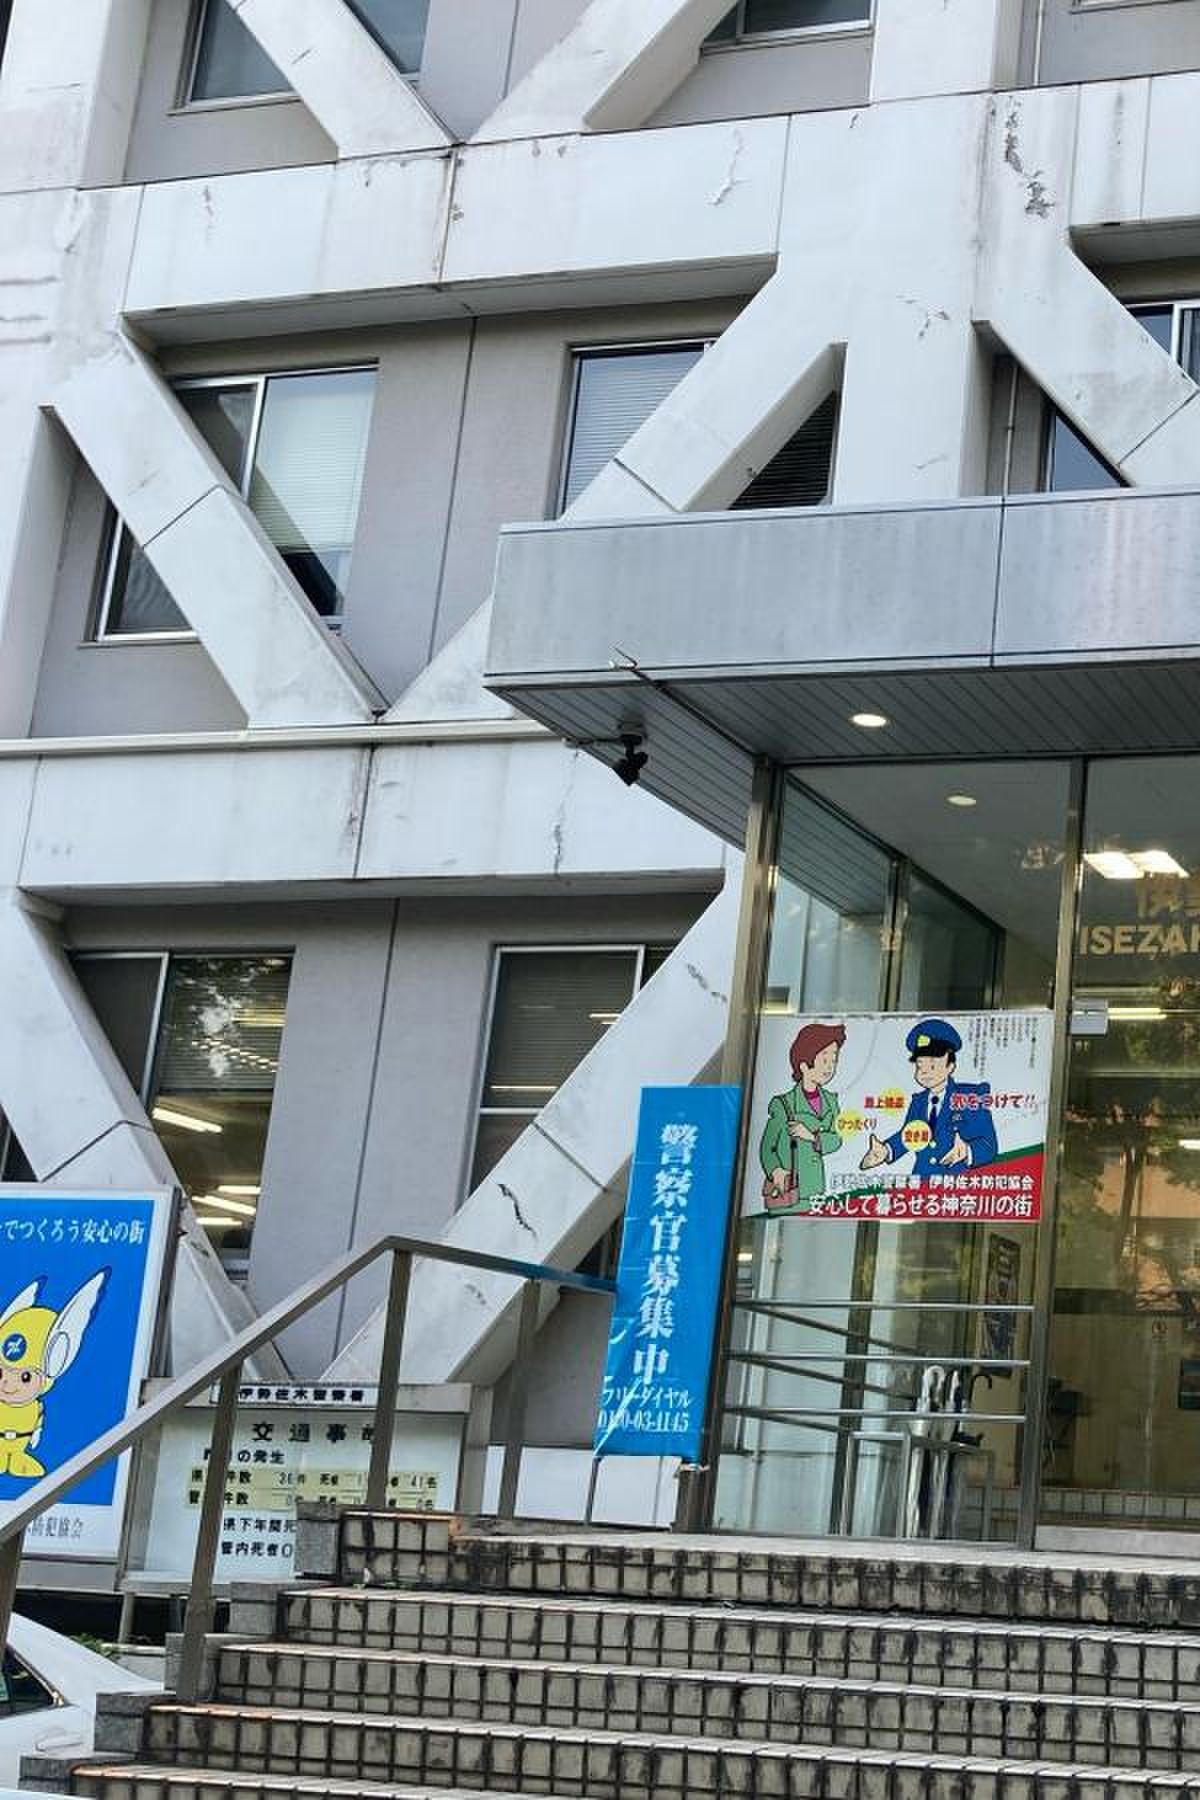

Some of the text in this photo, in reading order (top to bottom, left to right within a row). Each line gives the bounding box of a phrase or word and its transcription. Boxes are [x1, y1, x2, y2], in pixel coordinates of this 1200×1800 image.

[808, 1193, 1033, 1217] 安心して暮らせる神奈川の街
[0, 1218, 145, 1244] でつくろう安心の街
[633, 1123, 699, 1385] 警察官募集中
